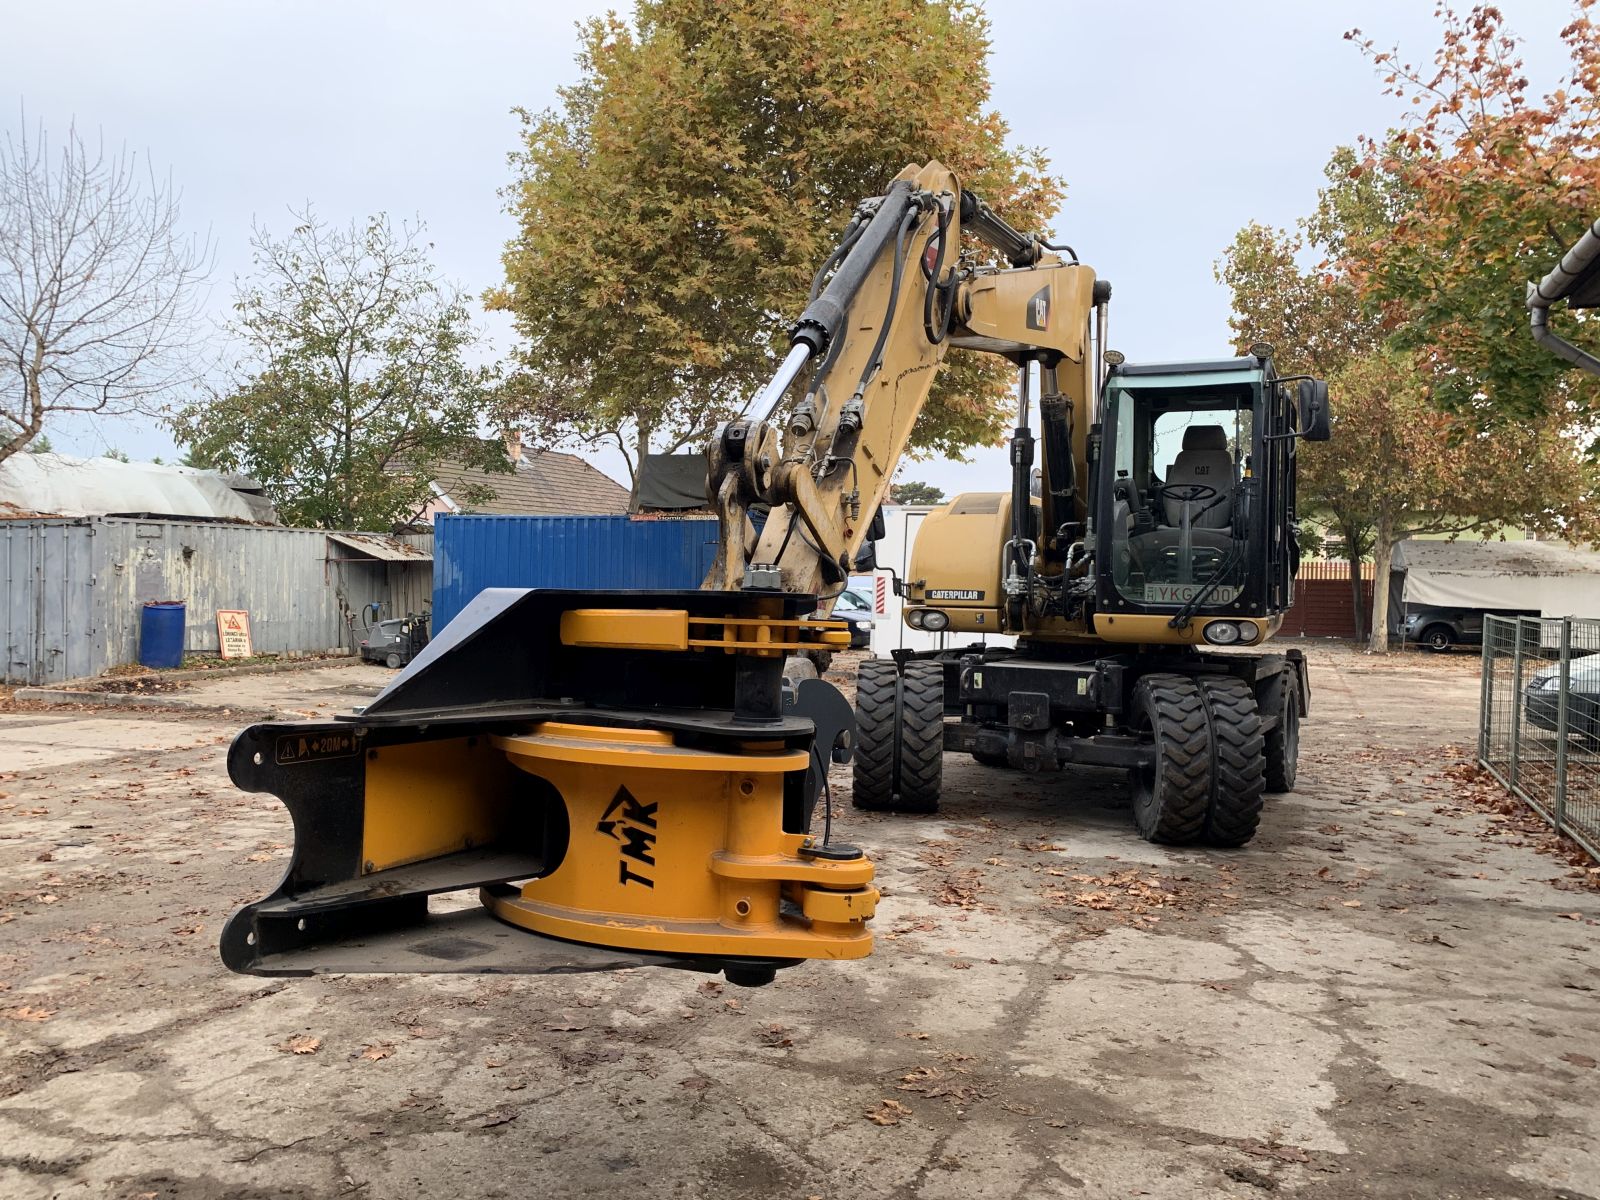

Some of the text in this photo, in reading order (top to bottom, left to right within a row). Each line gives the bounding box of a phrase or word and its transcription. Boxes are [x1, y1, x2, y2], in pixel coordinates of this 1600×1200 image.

[1035, 297, 1047, 327] CAT
[1194, 465, 1210, 476] CAT
[931, 590, 978, 600] CATERPILLAR
[320, 737, 341, 753] 20M
[619, 784, 658, 889] TMR
